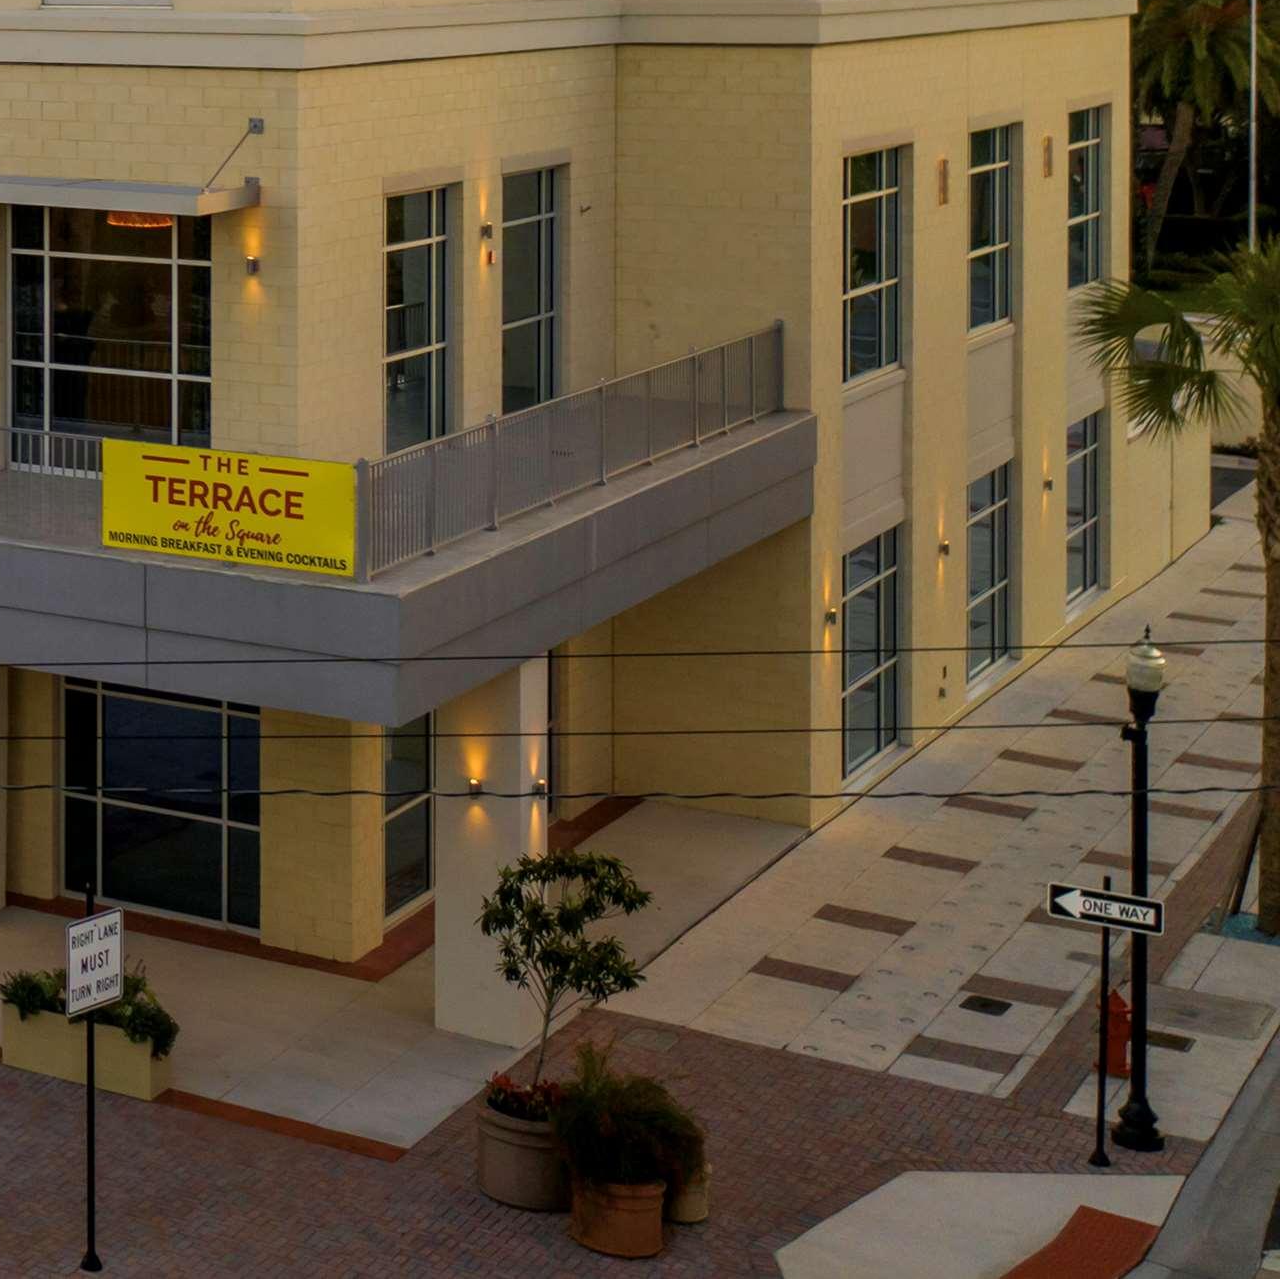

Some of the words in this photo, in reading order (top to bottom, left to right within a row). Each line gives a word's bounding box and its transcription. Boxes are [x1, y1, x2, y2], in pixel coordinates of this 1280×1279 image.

[199, 454, 250, 476] THE
[145, 474, 304, 520] TERRACE
[172, 519, 191, 532] on
[194, 510, 220, 538] the
[225, 519, 281, 546] Square
[108, 530, 158, 547] MORNING
[160, 536, 222, 556] BREAKFAST
[225, 544, 233, 557] &
[236, 546, 283, 563] EVENING
[286, 552, 347, 571] COCKTAILS
[1082, 899, 1113, 916] ONE
[1118, 904, 1150, 922] WAY
[71, 928, 95, 950] RIGHT
[97, 921, 119, 941] LANE
[80, 949, 110, 974] MUST
[71, 984, 91, 1003] TURN
[96, 973, 120, 994] RIGHT
